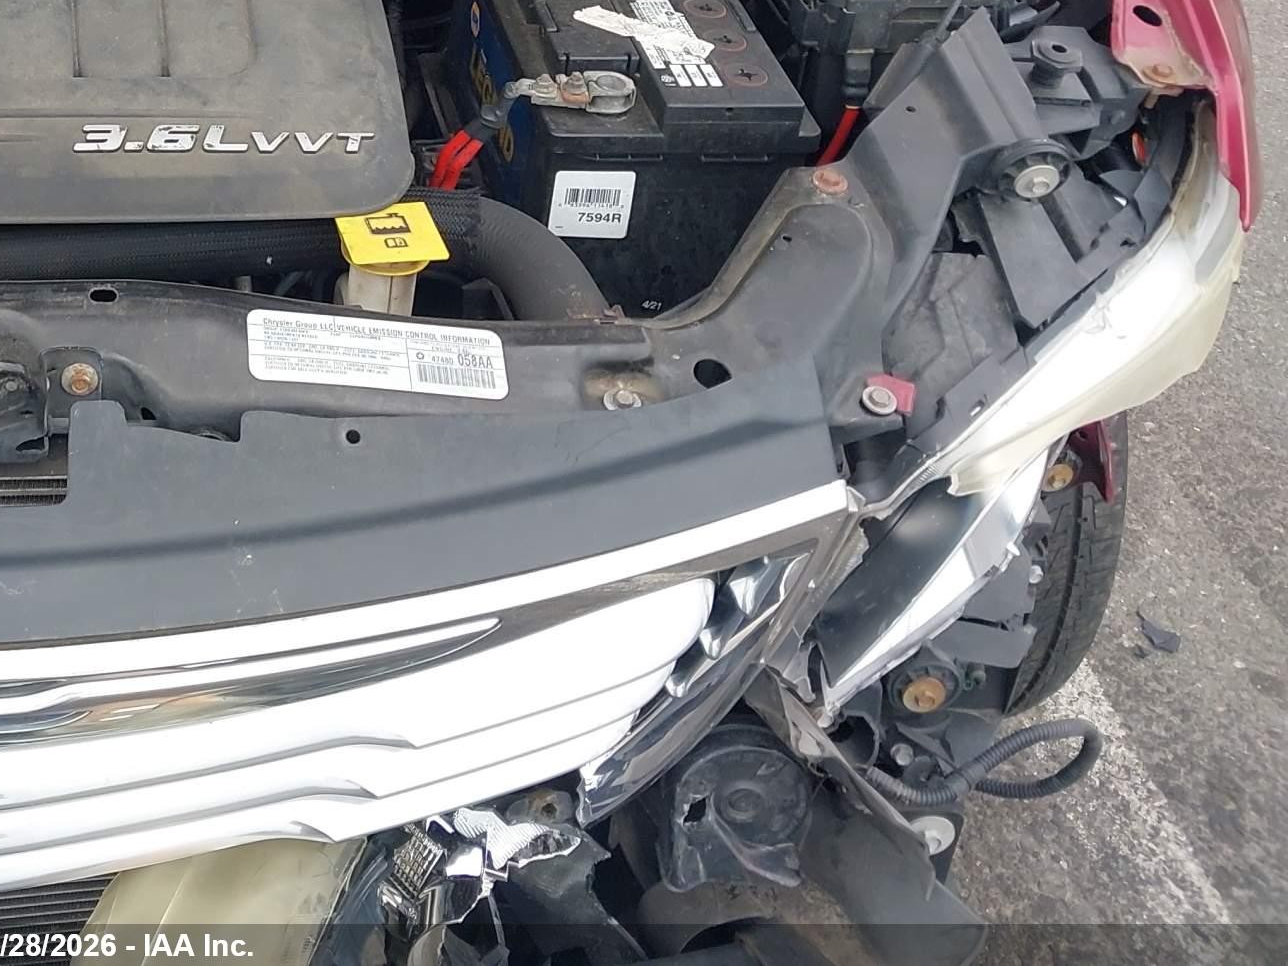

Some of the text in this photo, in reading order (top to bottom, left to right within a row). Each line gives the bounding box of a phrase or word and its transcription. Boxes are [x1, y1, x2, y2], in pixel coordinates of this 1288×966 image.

[578, 212, 622, 223] 7594R
[263, 317, 293, 327] Chrysler
[295, 320, 318, 329] Group
[320, 323, 334, 331] LLC
[337, 324, 366, 334] VEHICLE
[368, 327, 403, 338] EMISSION
[405, 331, 438, 340] CONTROL
[440, 334, 490, 346] INFORMATION
[457, 353, 494, 369] 058AA
